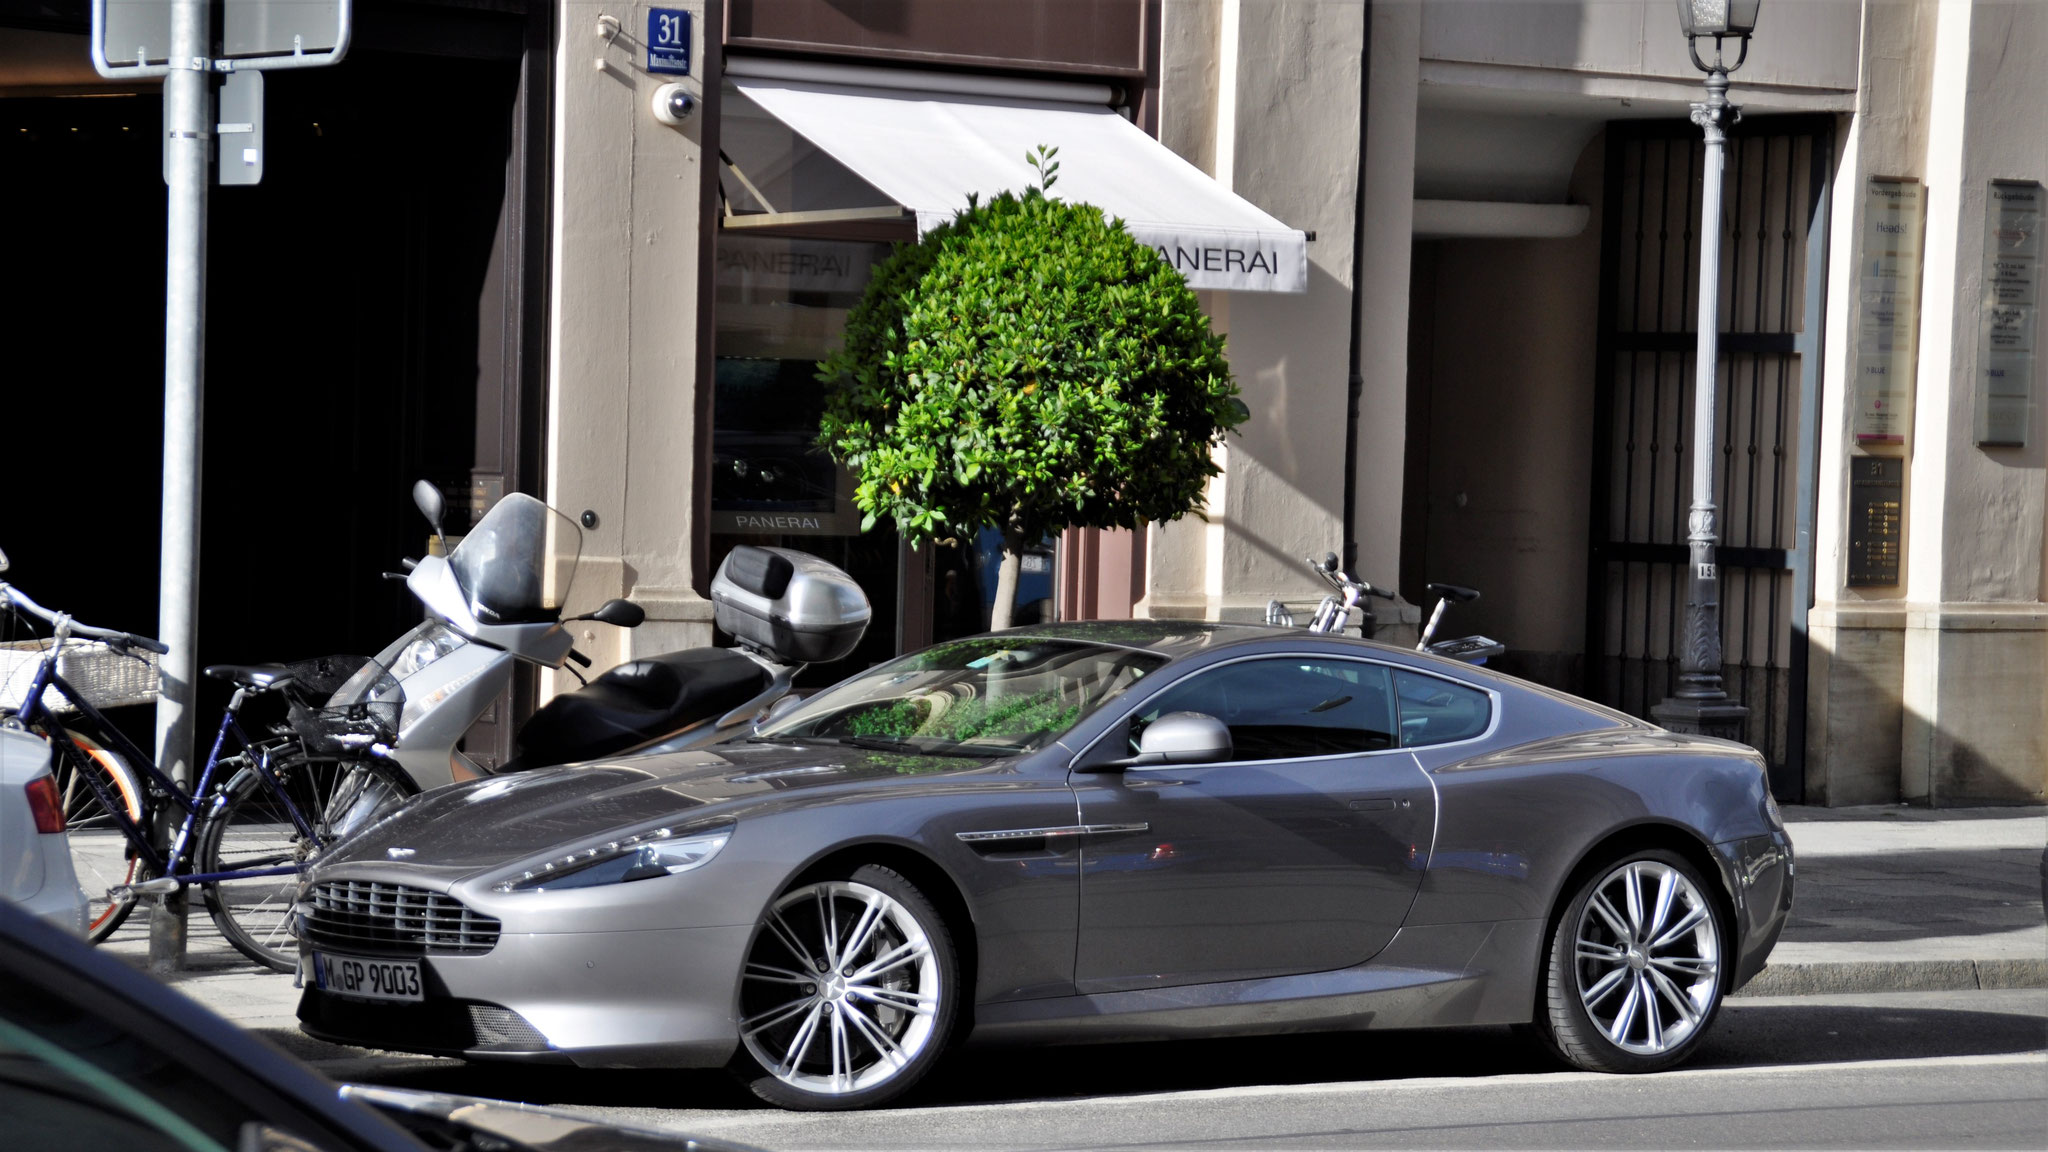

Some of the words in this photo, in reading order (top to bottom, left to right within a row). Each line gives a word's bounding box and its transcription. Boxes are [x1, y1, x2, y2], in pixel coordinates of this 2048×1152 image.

[658, 14, 682, 45] 31
[1876, 220, 1908, 234] Heads!
[1154, 244, 1278, 274] ANERAI
[736, 516, 819, 528] PANERAI
[323, 958, 336, 987] M
[342, 961, 364, 991] GP
[369, 964, 419, 995] 9003
